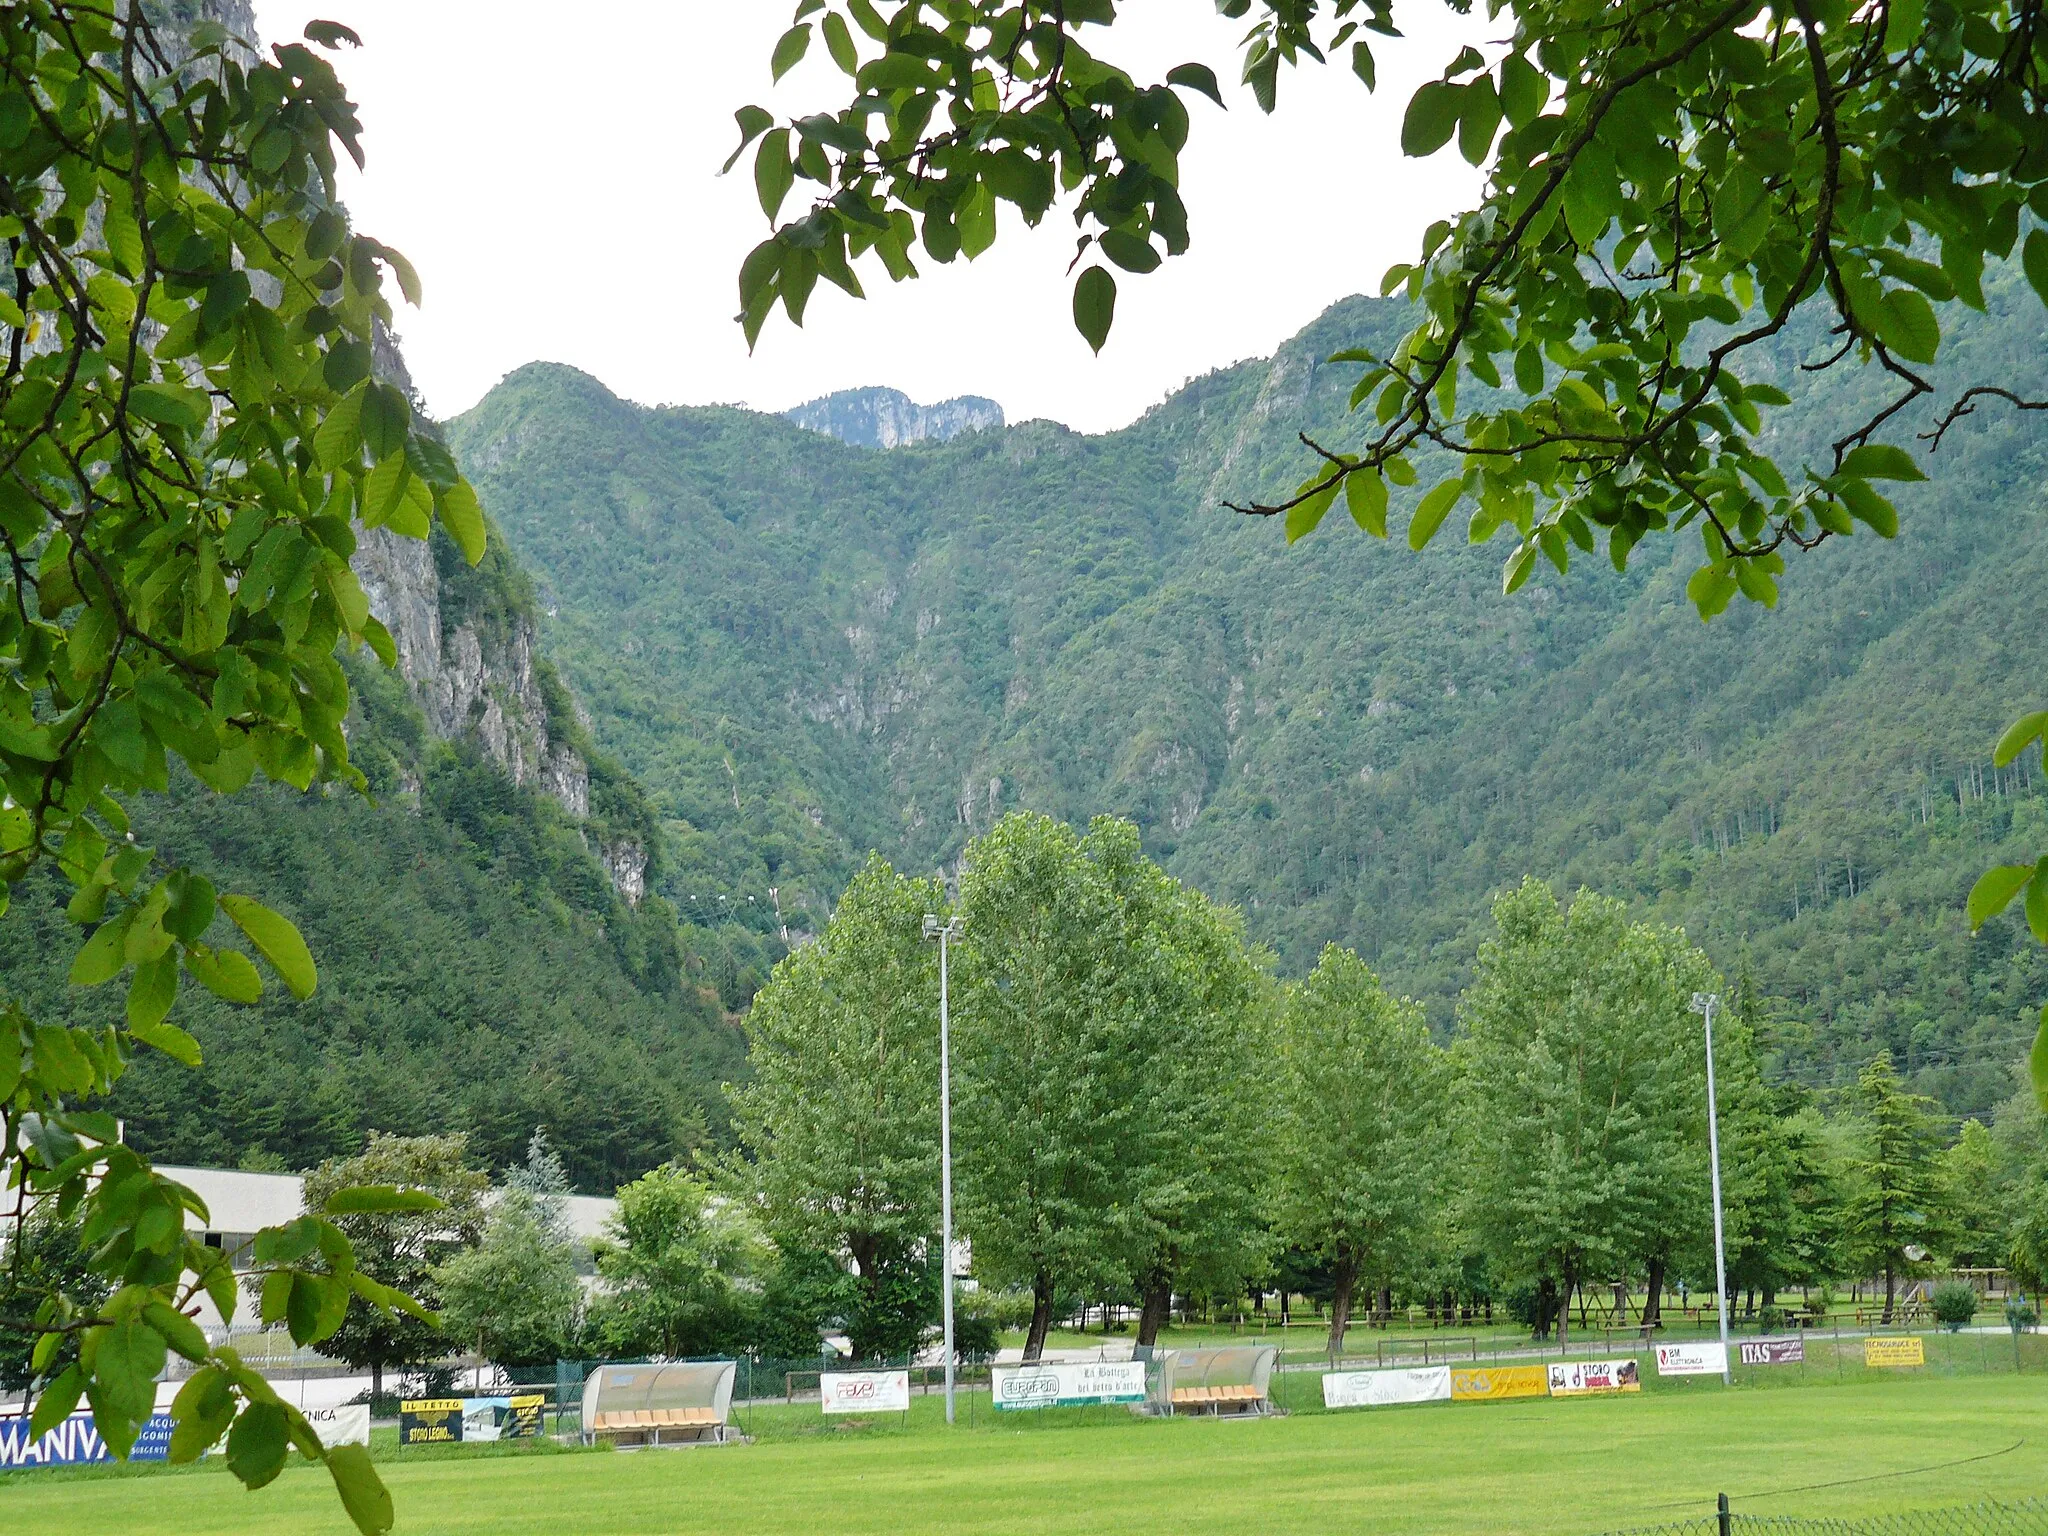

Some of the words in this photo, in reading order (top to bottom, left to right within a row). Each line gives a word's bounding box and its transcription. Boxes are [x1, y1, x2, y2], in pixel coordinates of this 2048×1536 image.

[1669, 1348, 1681, 1357] BM
[1741, 1343, 1771, 1364] ITAS
[1098, 1364, 1130, 1378] Bottega
[1583, 1363, 1611, 1376] STORO
[405, 1402, 416, 1410] IL
[423, 1401, 459, 1409] TETTO
[149, 1419, 181, 1429] ACQU
[409, 1427, 428, 1441] STORO
[428, 1426, 449, 1440] LEGNO
